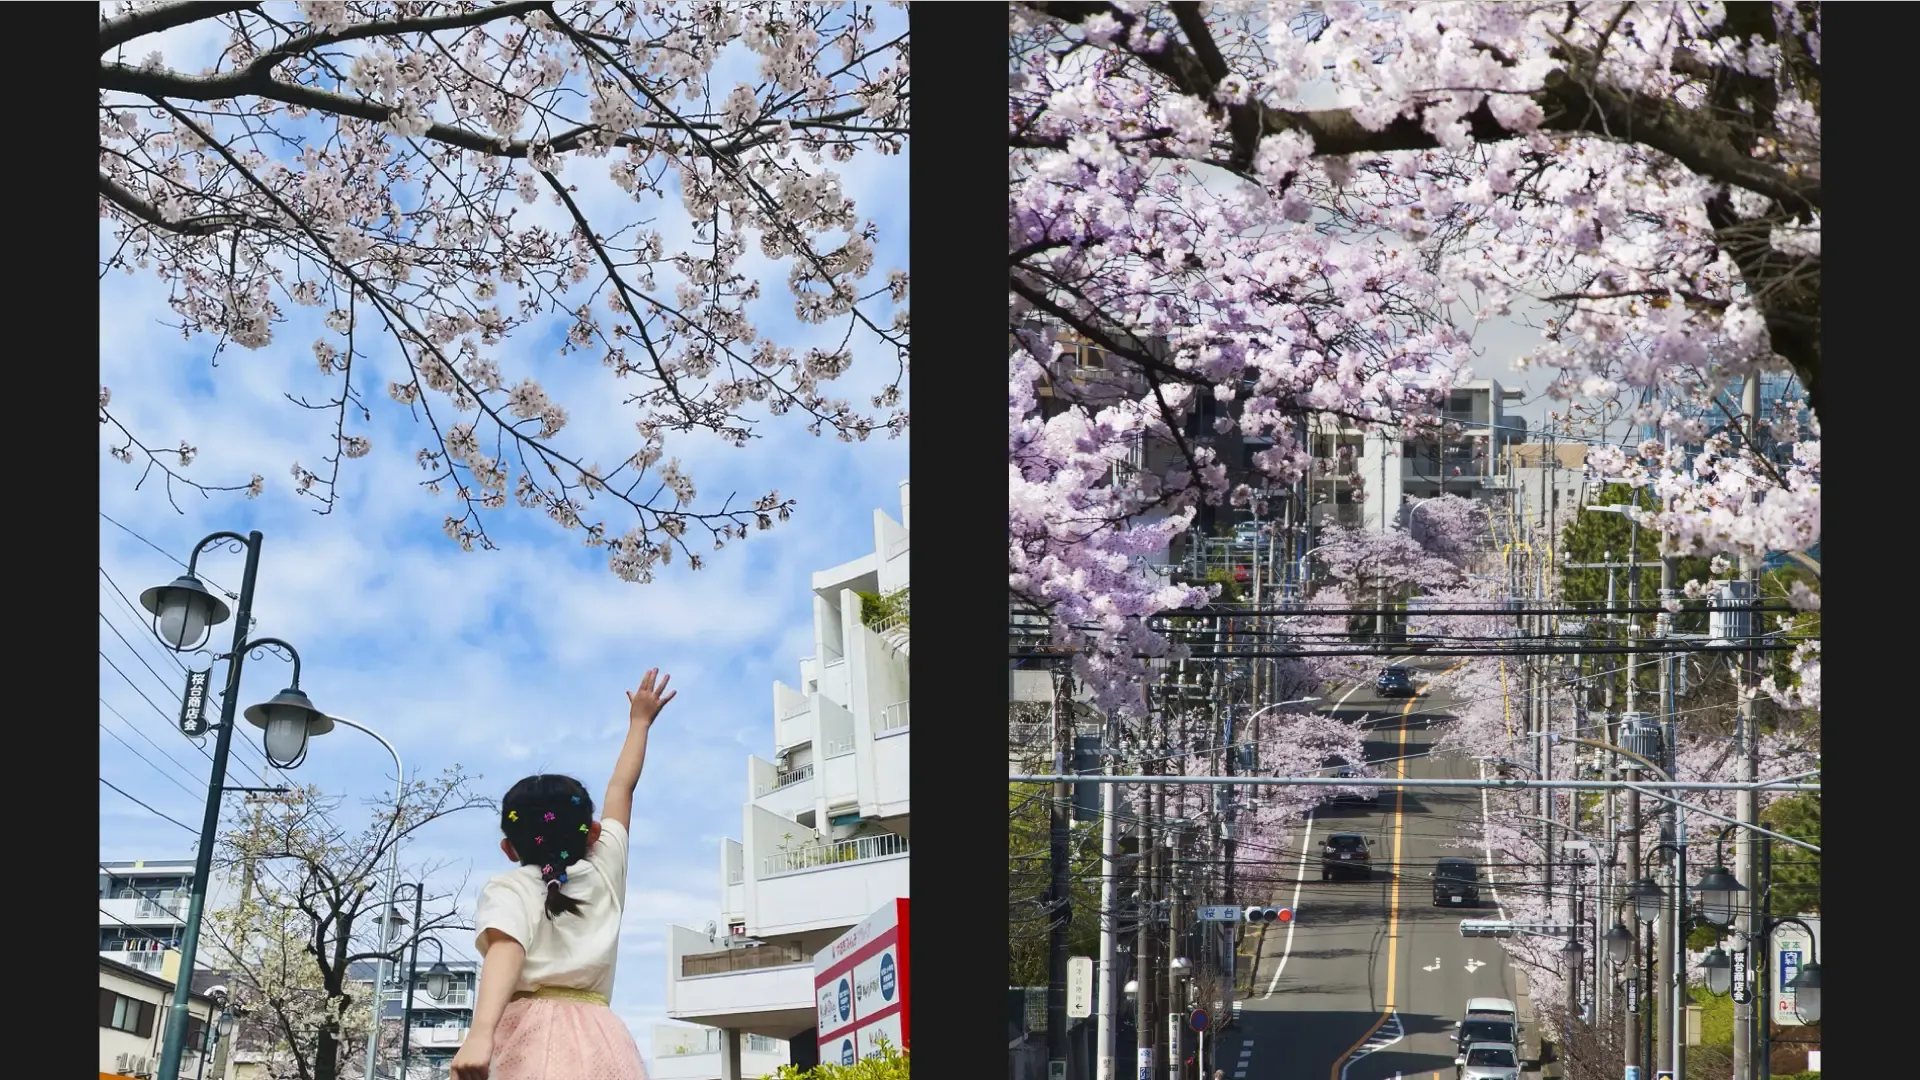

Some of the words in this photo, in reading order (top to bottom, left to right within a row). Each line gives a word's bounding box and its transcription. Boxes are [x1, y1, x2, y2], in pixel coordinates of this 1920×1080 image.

[184, 673, 206, 731] 桜台商店会
[1204, 908, 1234, 919] 桜台
[1733, 952, 1745, 1001] 桜台商店会
